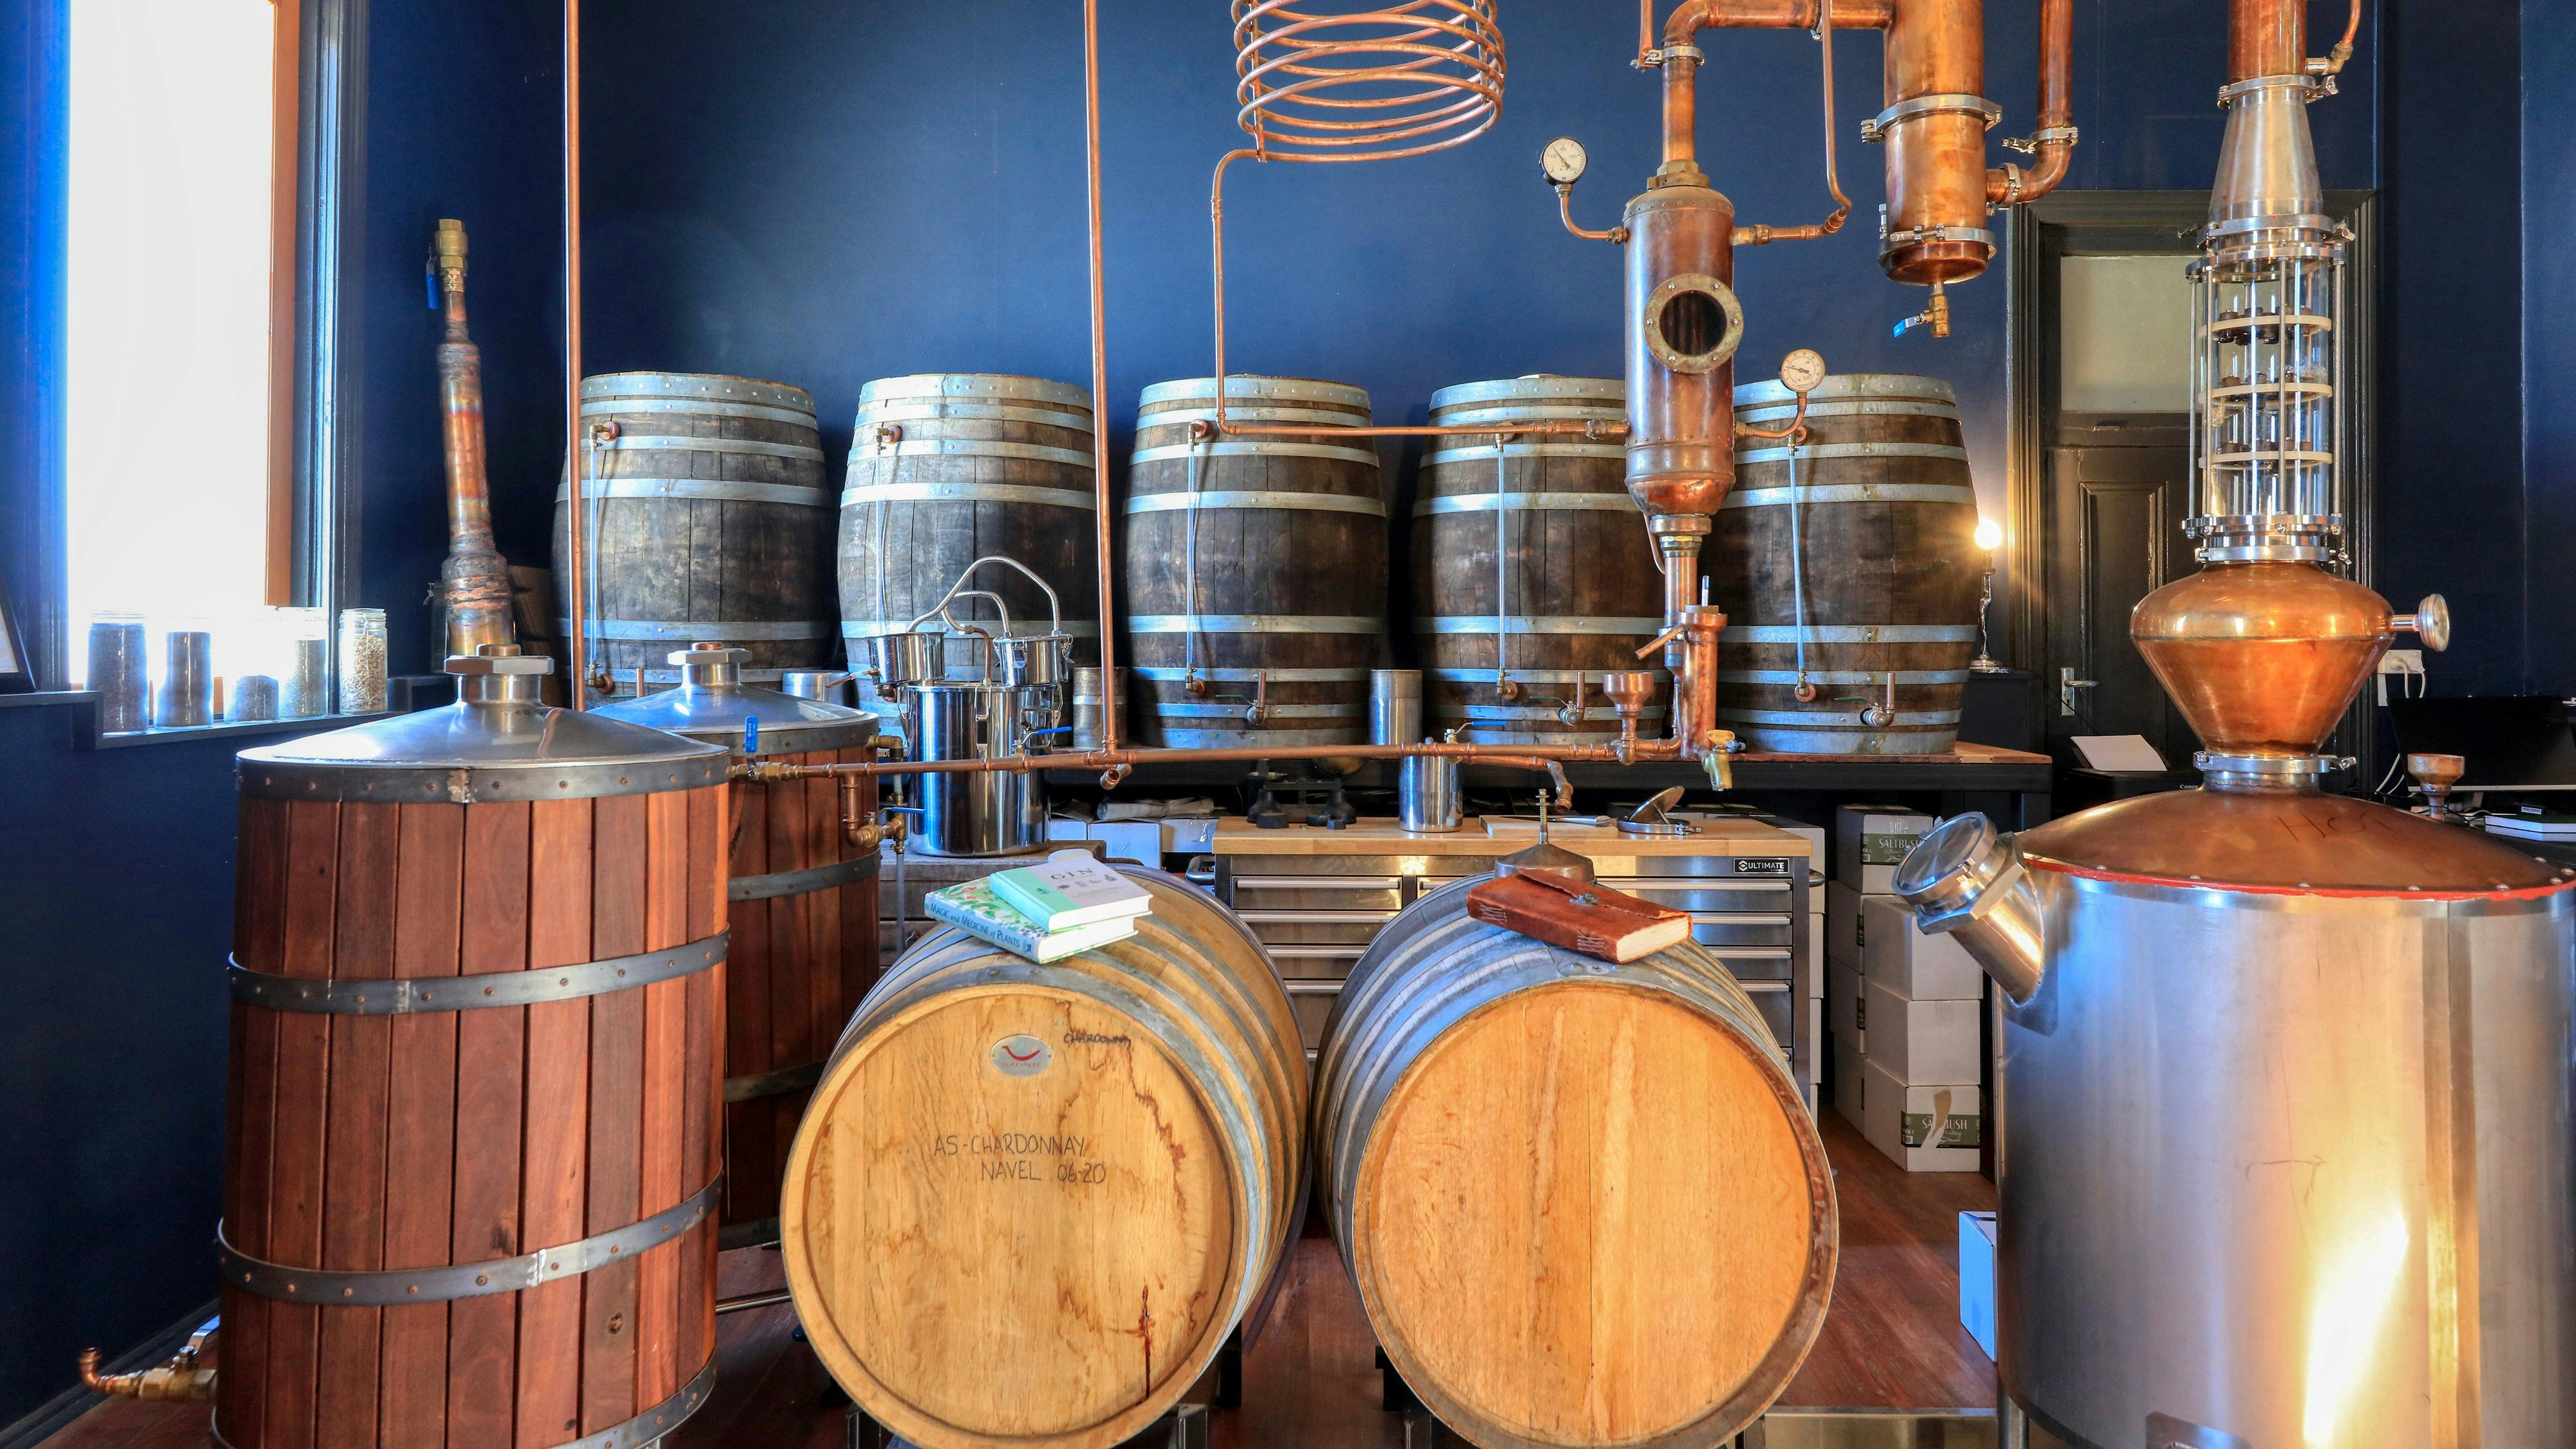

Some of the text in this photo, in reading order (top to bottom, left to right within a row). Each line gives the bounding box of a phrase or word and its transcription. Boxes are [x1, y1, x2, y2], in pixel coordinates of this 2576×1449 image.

[1051, 868, 1094, 880] GIN
[930, 904, 1020, 948] MAGIC and MEDICINE of PLANTS
[1922, 1118, 1967, 1130] SABUSH
[981, 1160, 1106, 1184] NAVEL 06-20
